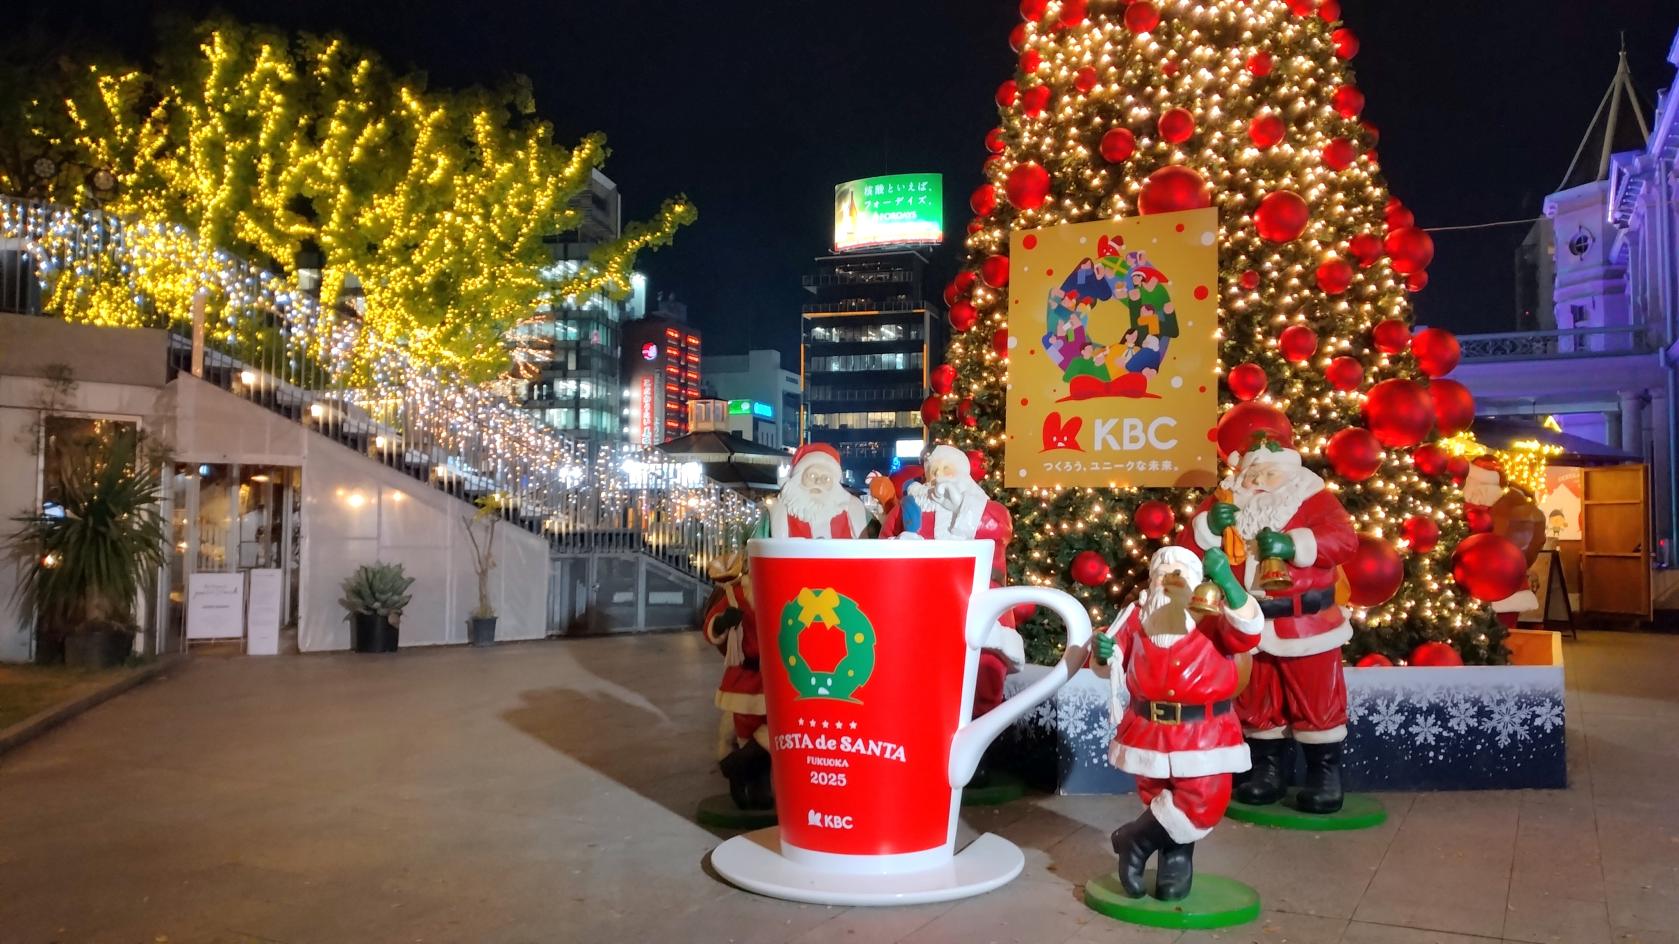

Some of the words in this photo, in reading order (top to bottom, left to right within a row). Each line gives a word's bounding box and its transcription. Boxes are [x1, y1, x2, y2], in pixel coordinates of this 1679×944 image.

[1094, 416, 1178, 451] KBC
[815, 734, 837, 750] de
[840, 736, 906, 762] SANTA
[806, 755, 849, 768] FUKUOKA
[810, 771, 847, 787] 2025
[824, 814, 854, 830] KBC
